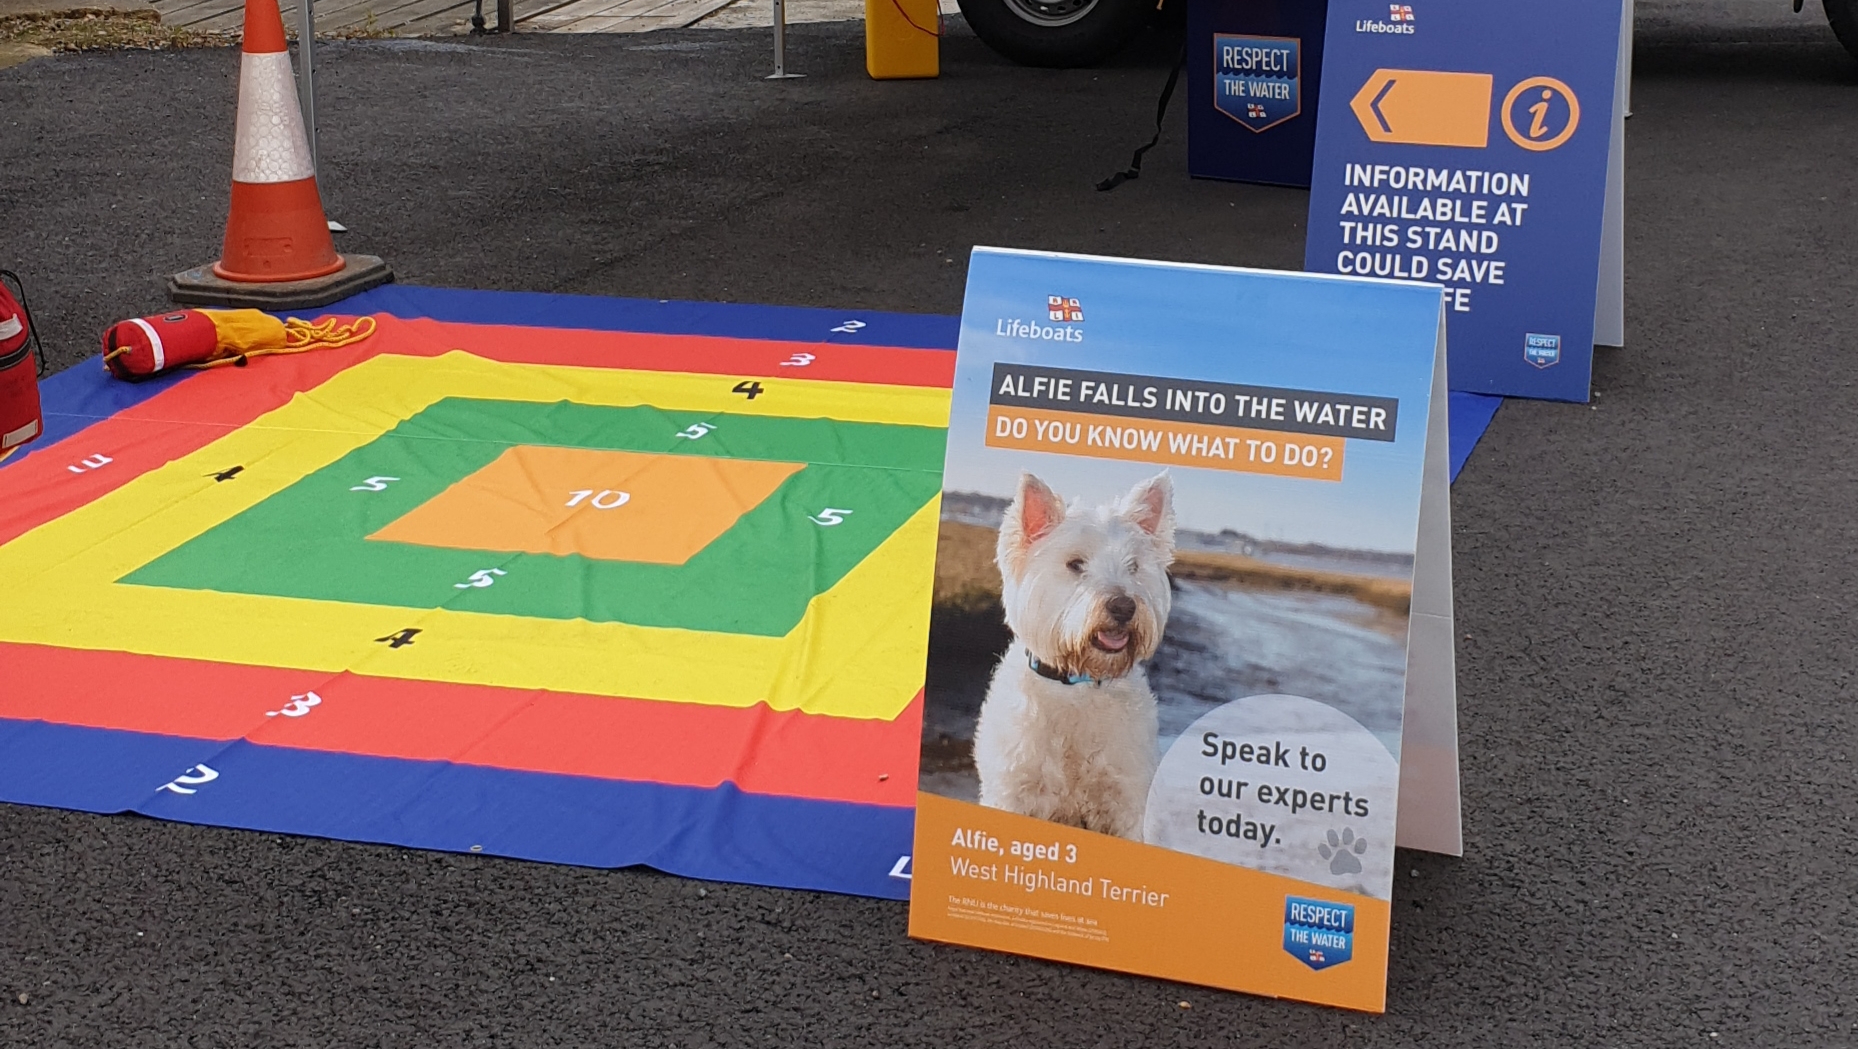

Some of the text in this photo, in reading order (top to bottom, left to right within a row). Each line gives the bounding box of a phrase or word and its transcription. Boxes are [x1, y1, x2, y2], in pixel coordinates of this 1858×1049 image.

[1355, 20, 1415, 35] Lifeboats
[1222, 44, 1291, 73] RESPECT
[1224, 79, 1291, 101] THE WATER
[1344, 163, 1530, 197] INFORMATION
[1340, 192, 1528, 227] AVAILABLE AT
[1339, 221, 1499, 254] THIS STAND
[1337, 251, 1506, 285] COULD SAVE
[1444, 287, 1472, 312] FE
[830, 319, 867, 334] 2
[996, 318, 1083, 343] Lifeboats
[778, 352, 816, 367] 3
[731, 380, 764, 400] 4
[998, 374, 1388, 432] ALFIE FALLS INTO THE WATER
[675, 422, 717, 440] 5
[995, 416, 1333, 470] DO YOU KNOW WHAT TO DO?
[349, 476, 401, 492] 5
[564, 489, 631, 510] 10
[807, 507, 853, 527] 5
[453, 567, 508, 590] 5
[265, 690, 322, 718] 3
[1201, 732, 1327, 773] Speak to
[1199, 776, 1370, 818] our experts
[1197, 809, 1282, 849] today.
[951, 827, 1077, 864] Alfie, aged 3
[951, 856, 1170, 908] West Highland Terrier
[948, 895, 961, 904] The
[1291, 902, 1348, 929] RESPECT
[1290, 928, 1346, 950] THE WATER
